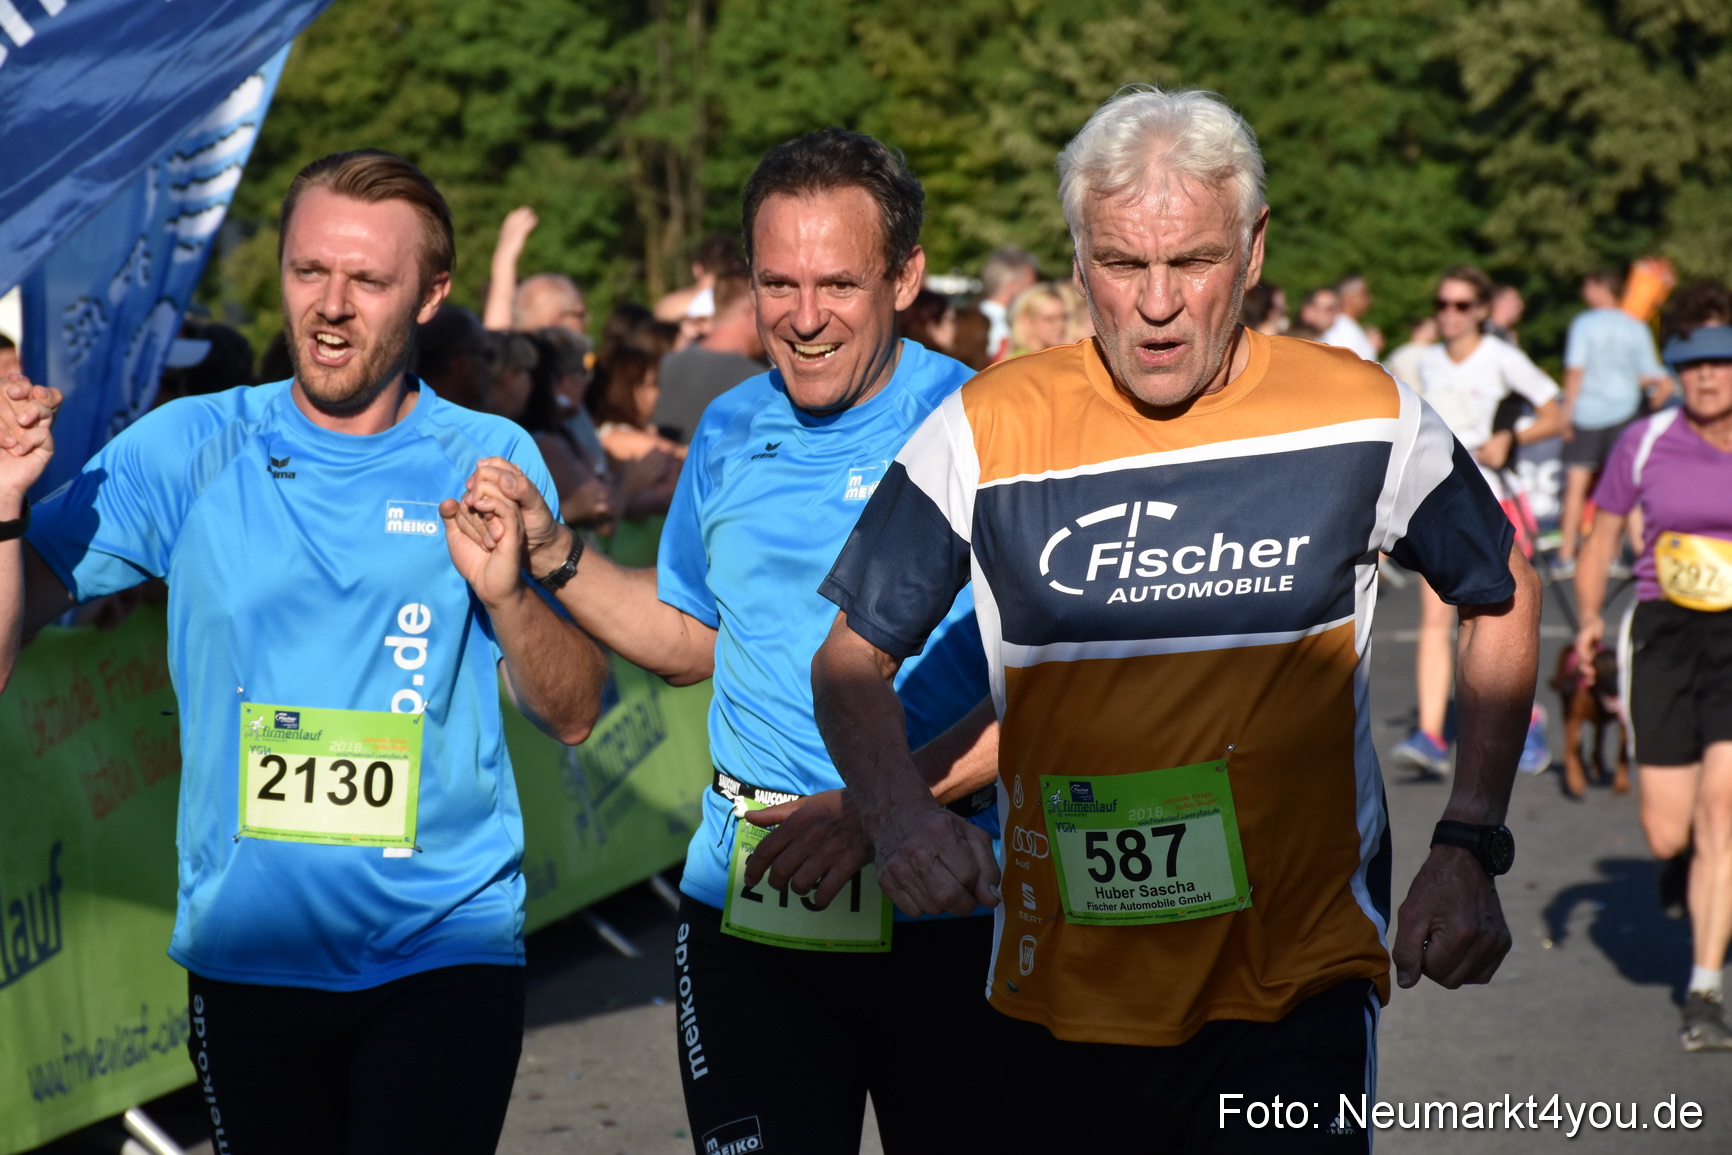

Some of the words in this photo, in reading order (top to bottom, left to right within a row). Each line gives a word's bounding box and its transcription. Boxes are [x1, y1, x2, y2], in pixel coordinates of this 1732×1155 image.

[387, 520, 437, 534] MEIKO
[1086, 532, 1310, 582] Fischer
[1106, 575, 1295, 604] AUTOMOBILE
[262, 726, 323, 741] firmenlauf
[329, 740, 363, 753] 2018
[257, 754, 394, 808] 2130
[1063, 799, 1118, 812] firmenlauf
[1128, 806, 1163, 821] 2018
[1085, 823, 1187, 884] 587
[1094, 885, 1135, 900] Huber
[1139, 881, 1195, 898] Sascha
[1086, 901, 1118, 912] Fischer
[1120, 896, 1176, 912] Automobile
[1179, 892, 1212, 906] GmbH
[1018, 910, 1043, 925] SEAT
[675, 922, 709, 1081] meiko.de
